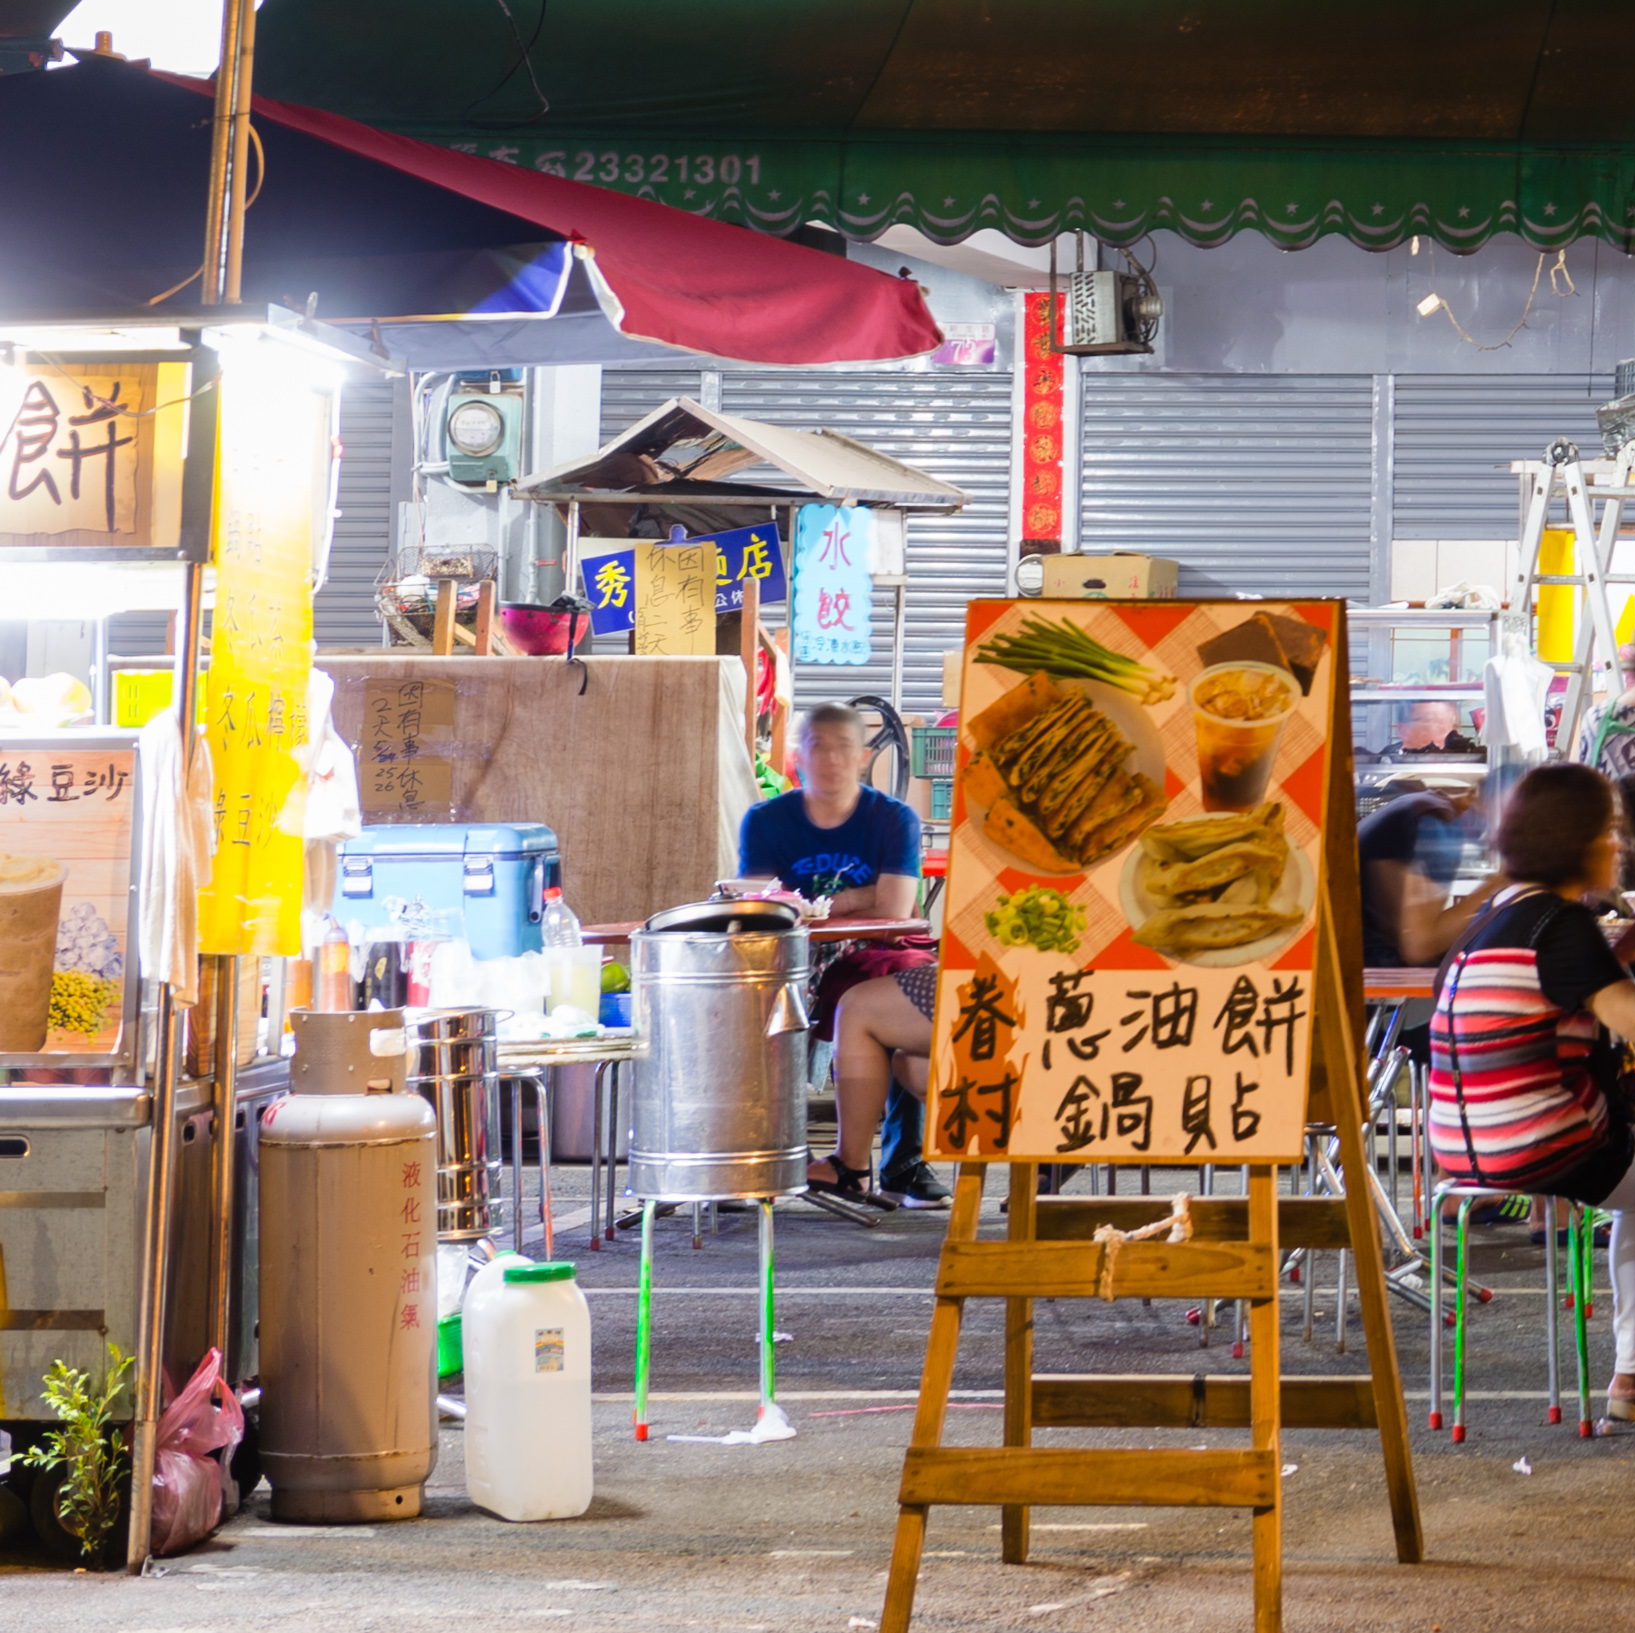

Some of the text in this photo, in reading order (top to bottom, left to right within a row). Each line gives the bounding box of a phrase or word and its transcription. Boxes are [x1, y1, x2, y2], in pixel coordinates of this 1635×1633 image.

[573, 150, 762, 185] 23321301
[951, 339, 976, 365] 73
[0, 381, 134, 533] 餅
[818, 521, 855, 632] 水餃
[0, 760, 129, 804] 綠豆沙
[397, 681, 425, 810] 因有事休息
[940, 976, 1019, 1150] 眷村
[1054, 1070, 1262, 1154] 鍋貼
[400, 1160, 422, 1331] 液化石油氣
